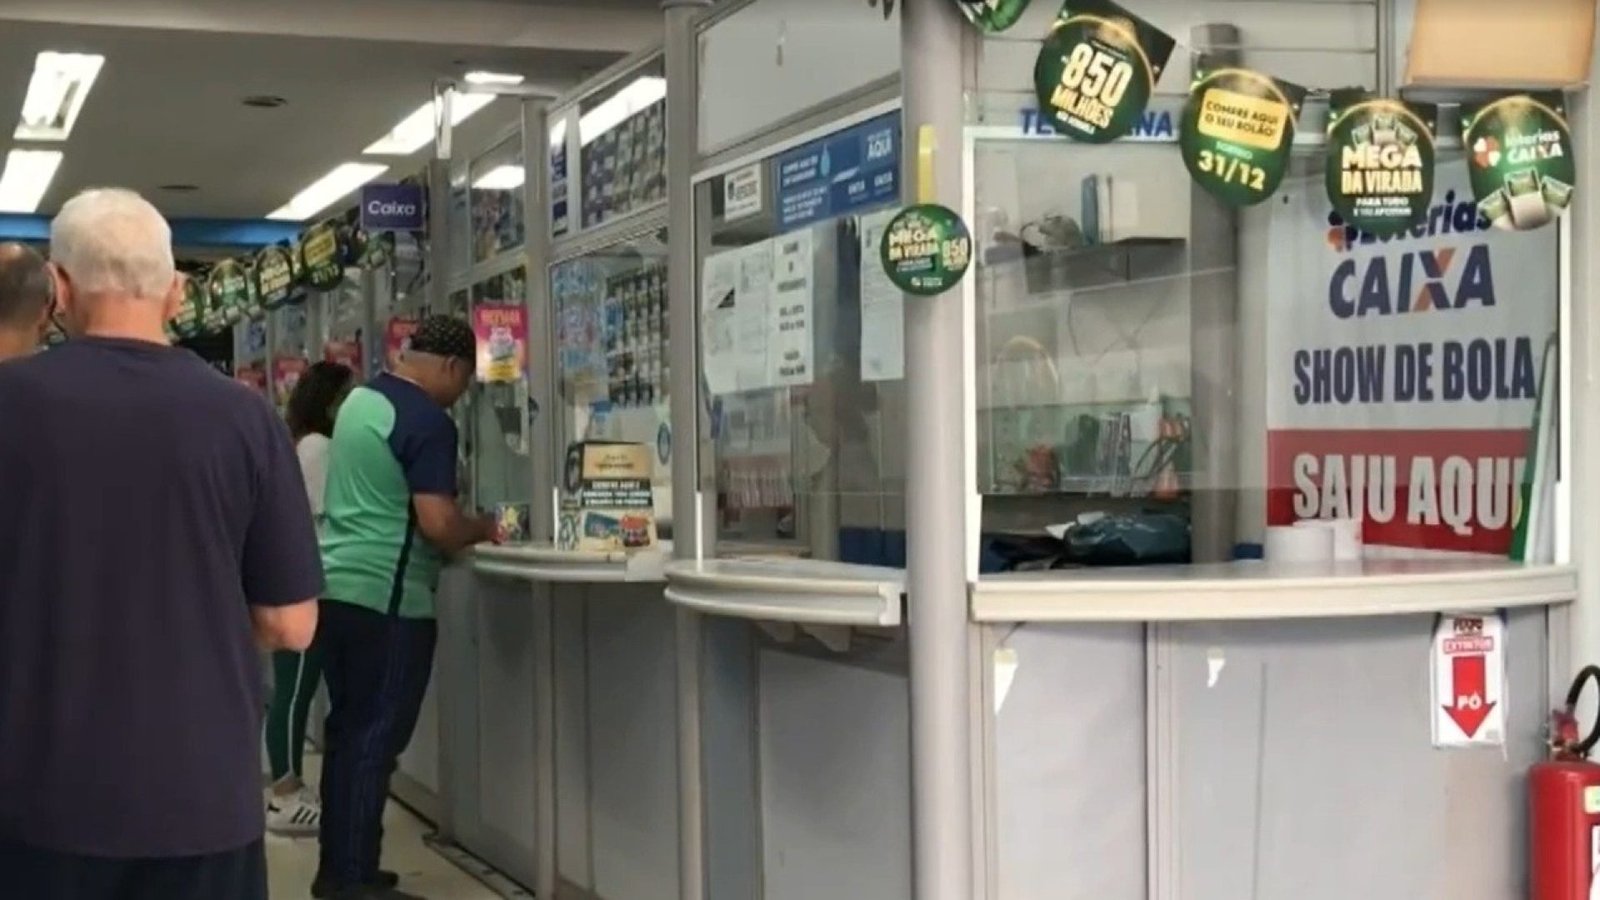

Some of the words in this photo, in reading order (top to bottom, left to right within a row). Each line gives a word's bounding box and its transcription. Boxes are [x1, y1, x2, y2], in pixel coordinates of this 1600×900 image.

[1061, 42, 1133, 107] 850
[1204, 113, 1215, 123] O
[1216, 116, 1235, 128] SEU
[1206, 100, 1249, 118] COMPRE
[1341, 143, 1423, 169] MEGA
[1507, 142, 1563, 164] CAIXA
[1198, 149, 1266, 190] 31/12
[1341, 170, 1364, 194] DA
[1364, 170, 1423, 193] VIRADA
[367, 200, 416, 216] Caixa
[1329, 244, 1495, 319] CAIXA
[1294, 345, 1386, 405] SHOW
[1394, 341, 1434, 402] DE
[1443, 336, 1537, 402] BOLA
[1293, 452, 1397, 524] SAIU
[1457, 691, 1482, 711] PÓ
